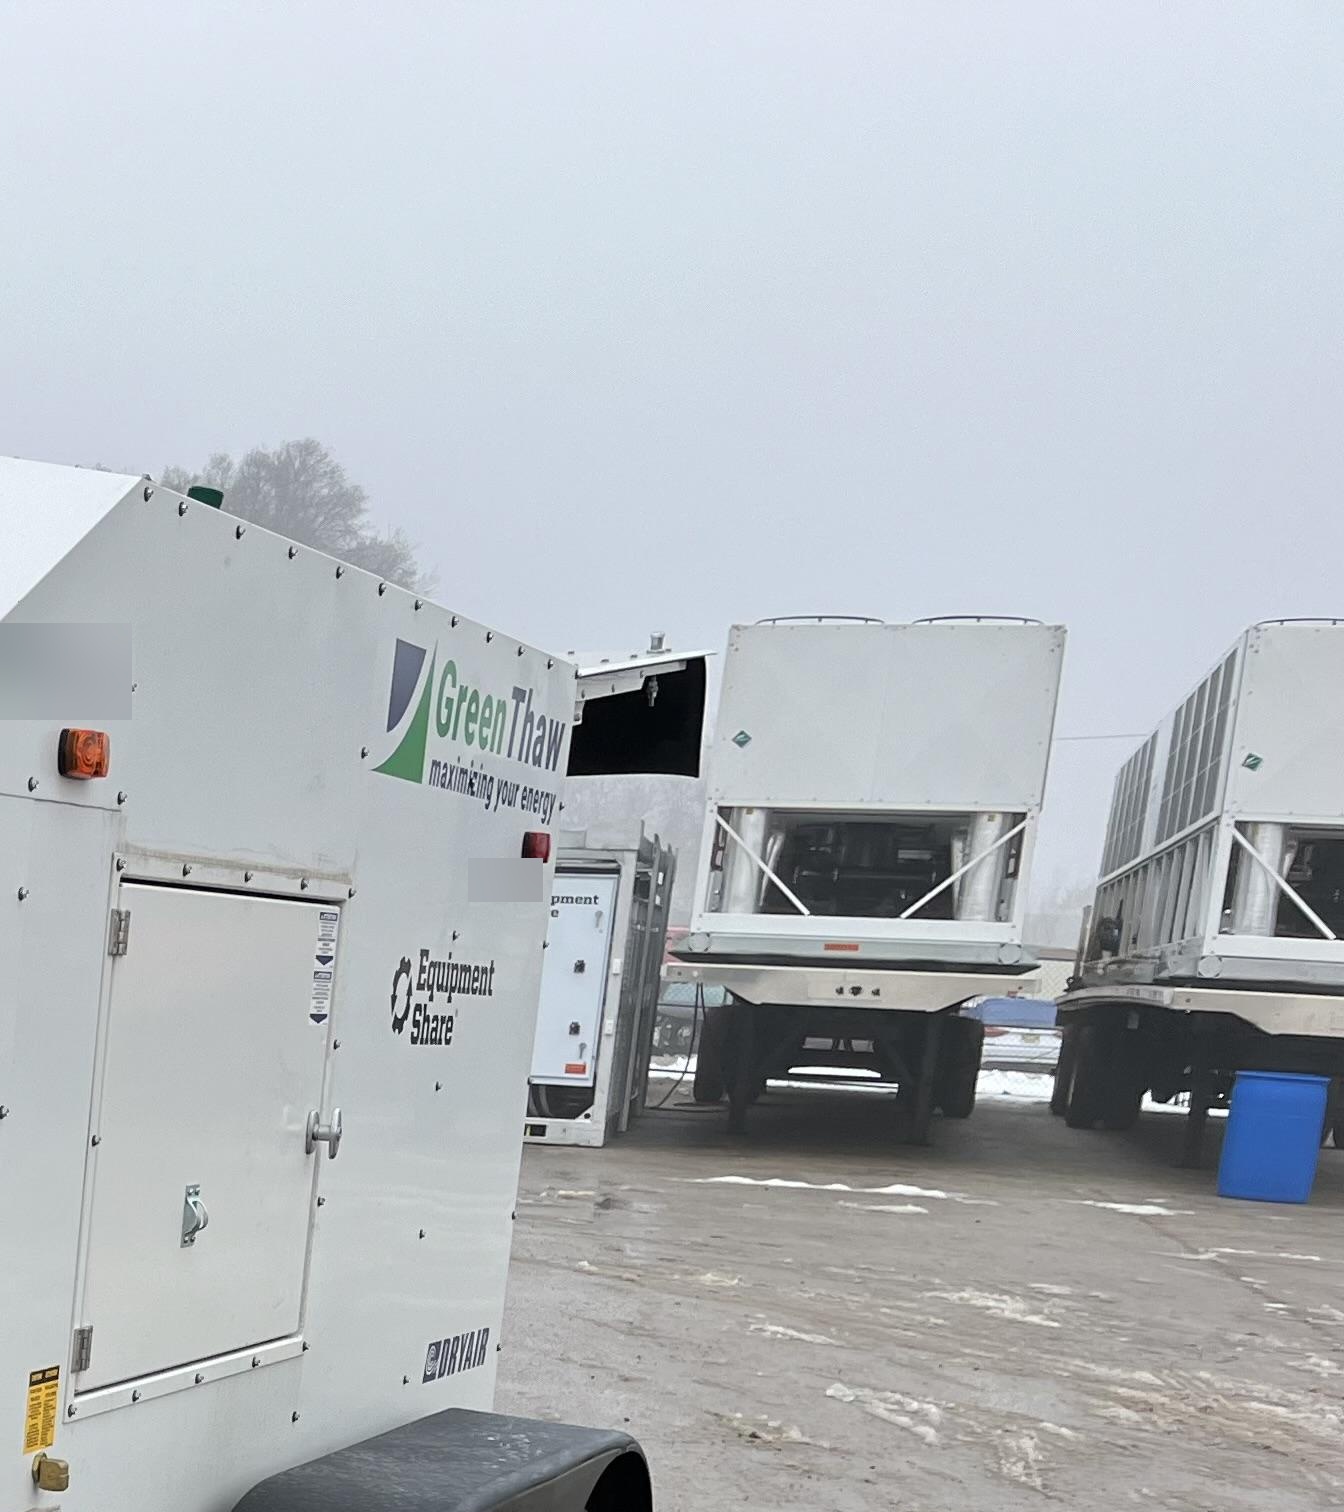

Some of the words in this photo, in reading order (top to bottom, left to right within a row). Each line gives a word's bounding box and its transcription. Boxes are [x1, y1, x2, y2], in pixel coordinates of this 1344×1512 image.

[429, 755, 494, 810] maximizing
[493, 778, 519, 812] your
[520, 785, 556, 825] energy
[416, 949, 495, 1003] Equipment
[411, 1003, 454, 1045] Share
[438, 1328, 490, 1379] DRYAIR
